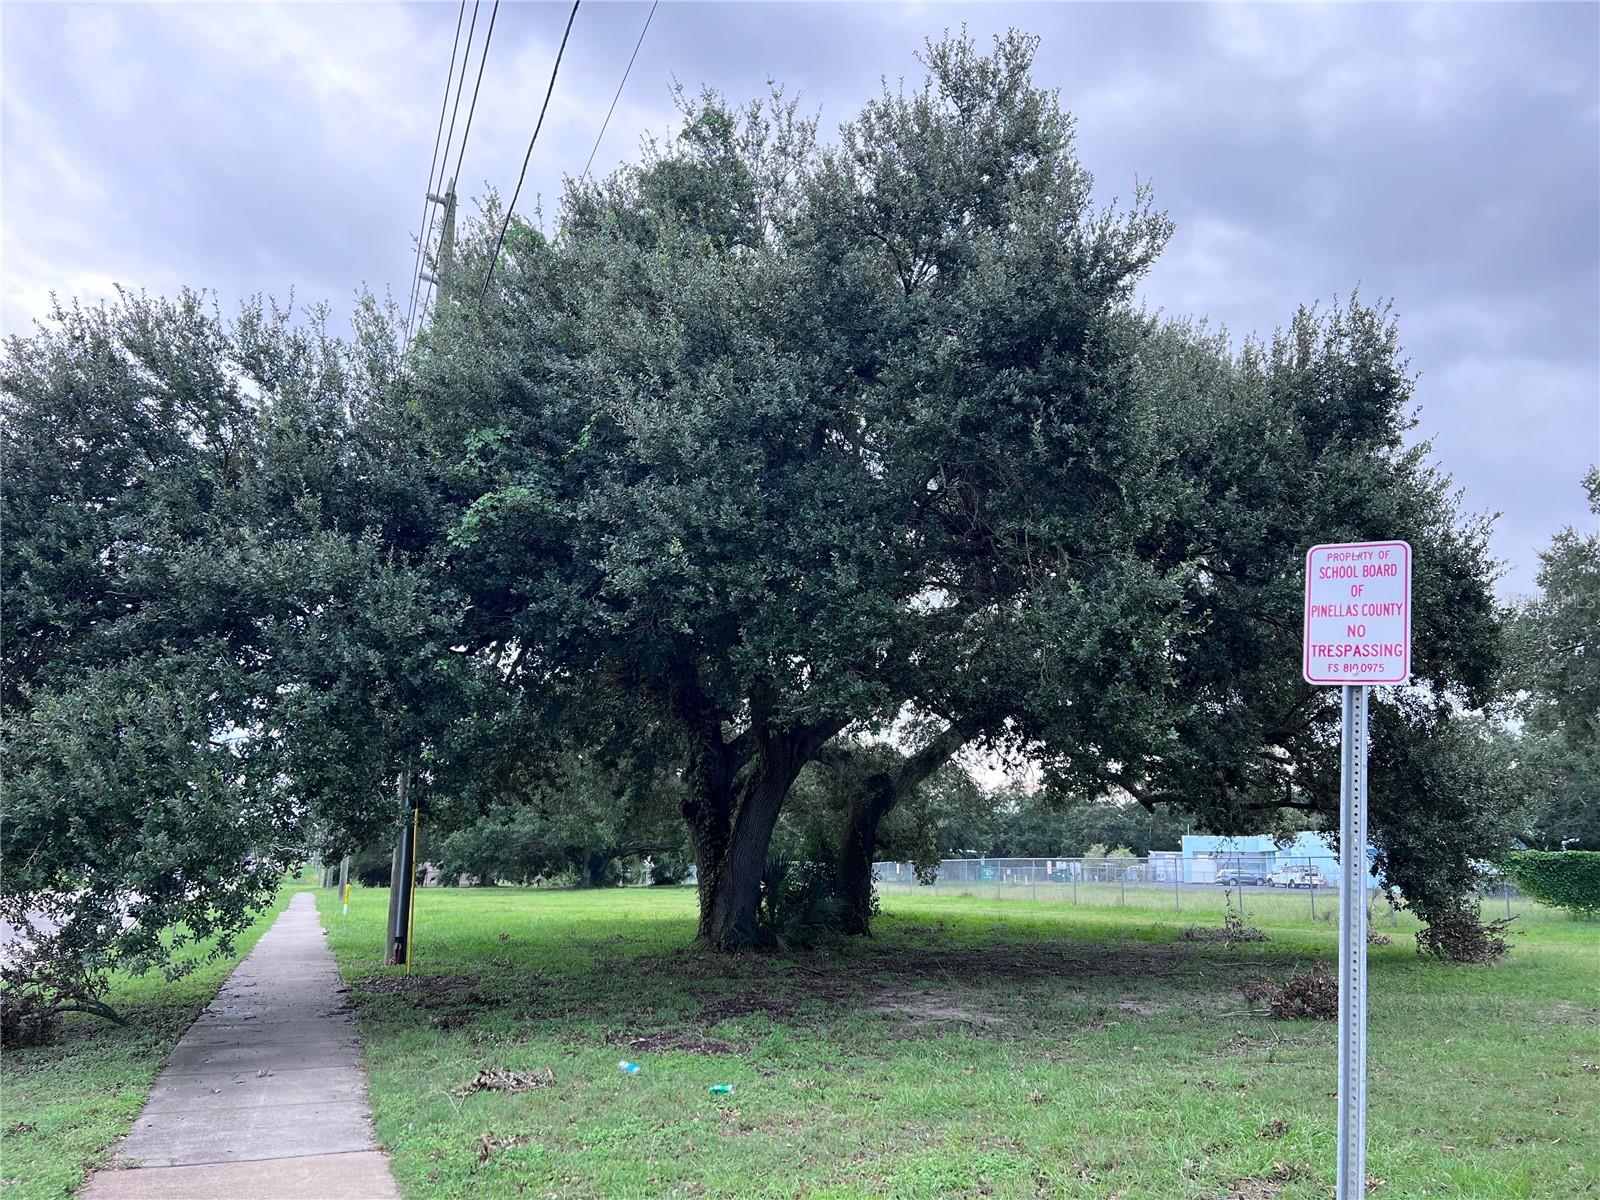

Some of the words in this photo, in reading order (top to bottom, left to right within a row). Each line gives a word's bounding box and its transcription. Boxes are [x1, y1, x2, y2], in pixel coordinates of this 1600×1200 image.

[1327, 551, 1373, 562] PROPERTY
[1379, 551, 1389, 559] OF
[1320, 566, 1358, 579] SCHOOL
[1363, 564, 1397, 577] BOARD
[1351, 585, 1364, 597] OF
[1312, 604, 1358, 617] PINELLAS
[1362, 603, 1403, 616] COUNTY
[1348, 625, 1365, 637] NO
[1312, 644, 1402, 657] TRESPASSING
[1328, 664, 1338, 672] FS
